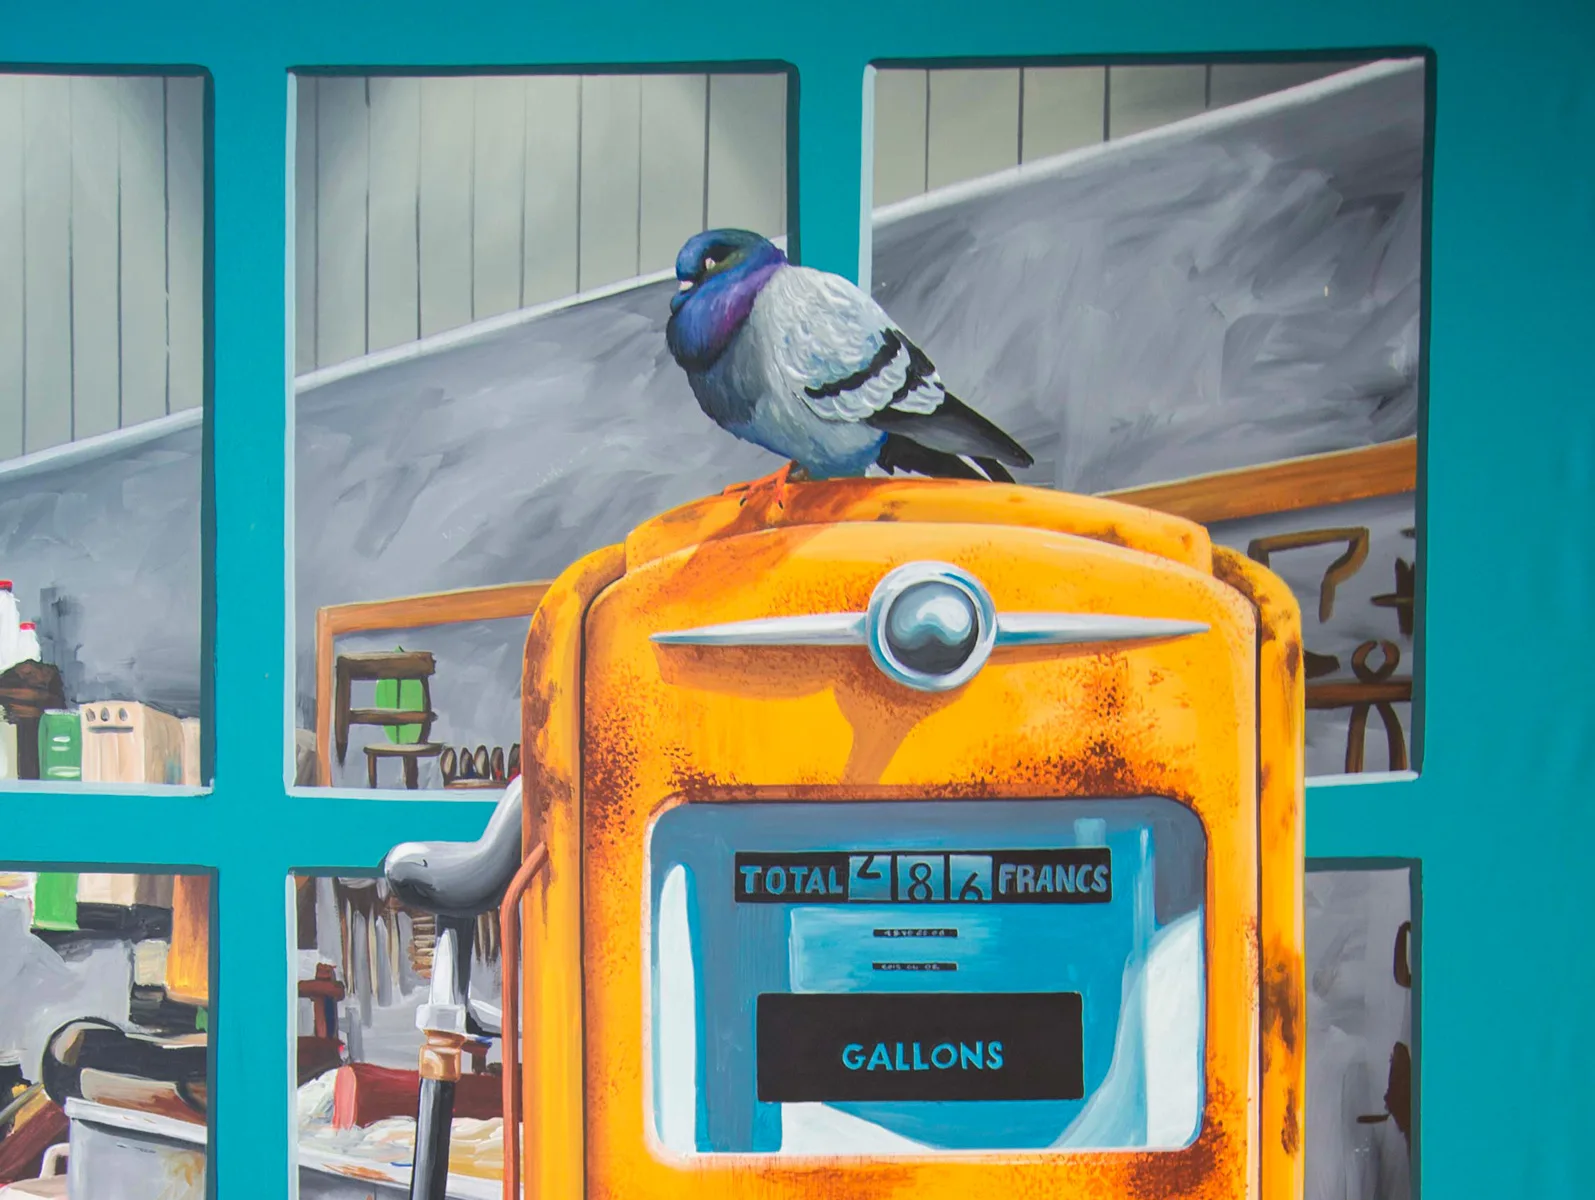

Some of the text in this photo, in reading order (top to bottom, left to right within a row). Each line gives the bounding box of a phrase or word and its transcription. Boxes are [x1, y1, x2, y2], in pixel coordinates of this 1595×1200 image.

[739, 865, 844, 895] TOTAL
[998, 863, 1109, 894] FRANCS
[842, 1041, 1004, 1071] GALLONS
